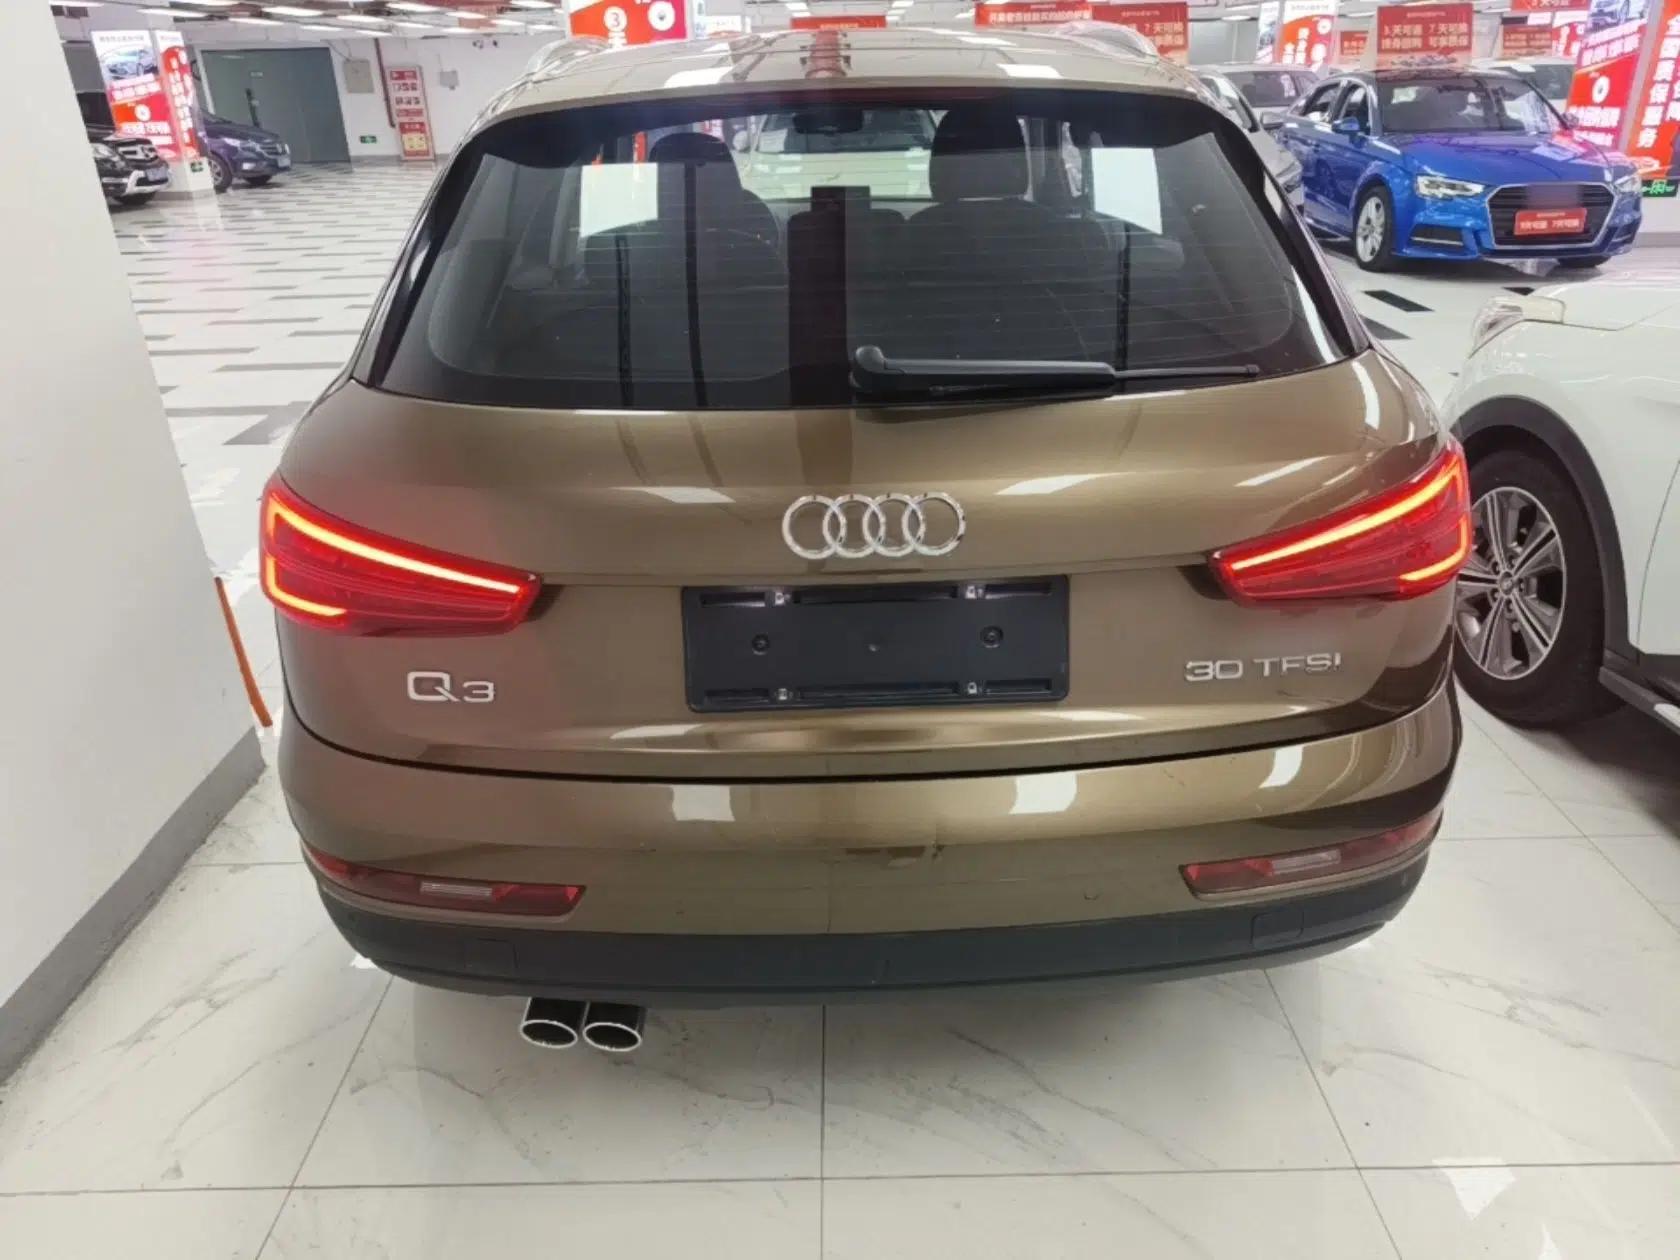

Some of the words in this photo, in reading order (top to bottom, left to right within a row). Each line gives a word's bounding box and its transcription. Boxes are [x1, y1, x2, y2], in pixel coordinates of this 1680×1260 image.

[1185, 659, 1244, 682] 30
[1253, 652, 1342, 678] TFSI
[406, 671, 496, 703] Q3
